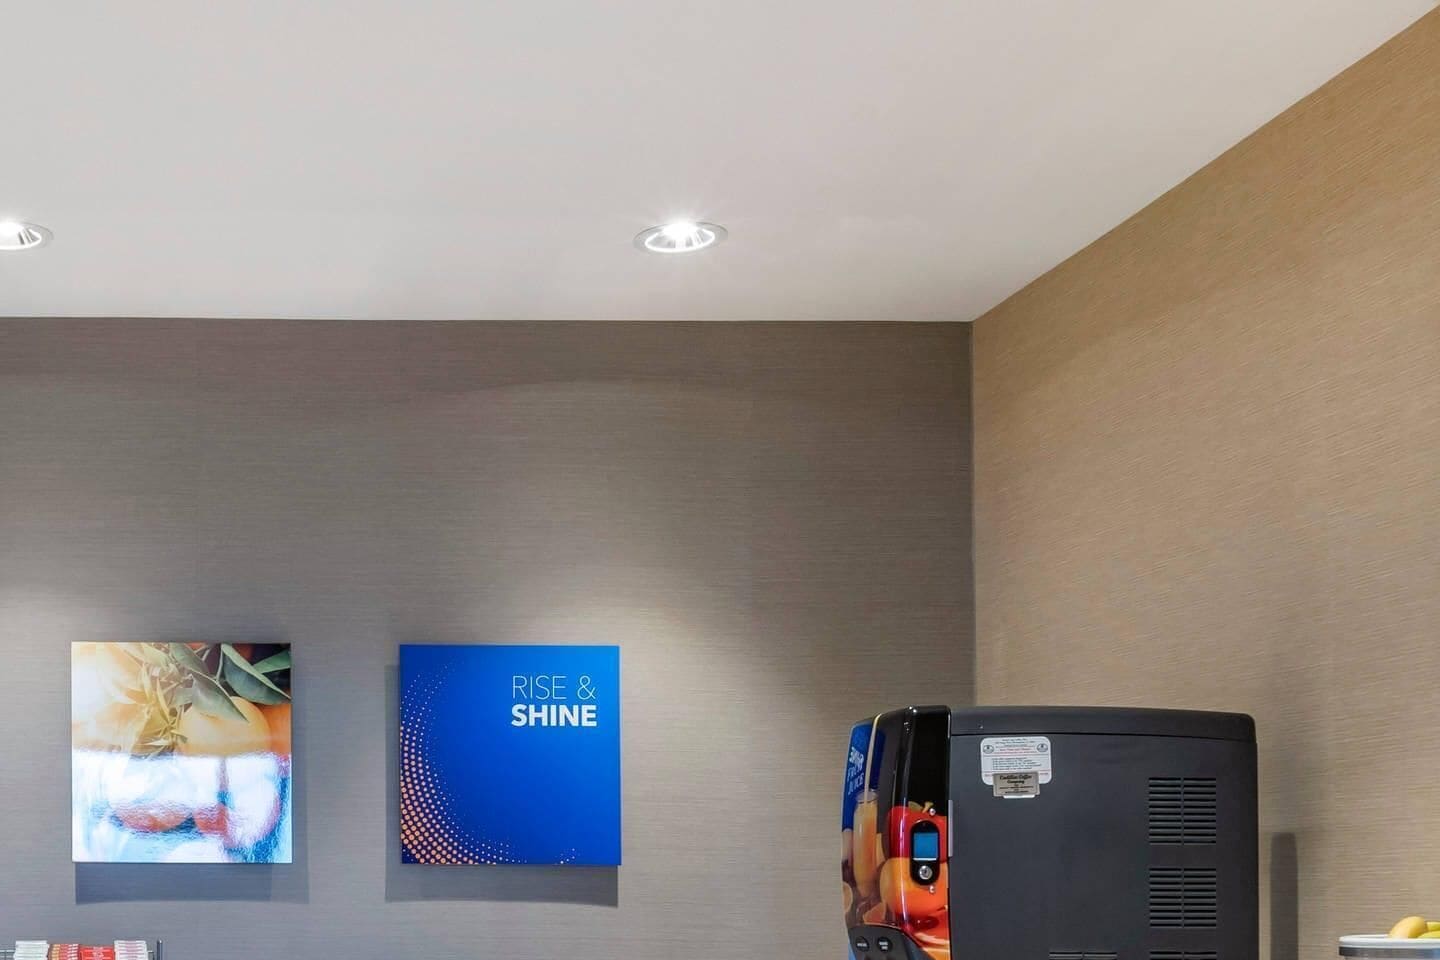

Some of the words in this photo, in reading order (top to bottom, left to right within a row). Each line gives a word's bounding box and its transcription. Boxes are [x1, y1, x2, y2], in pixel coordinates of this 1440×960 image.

[512, 675, 567, 699] RISE
[577, 675, 596, 699] &
[511, 704, 597, 727] SHINE
